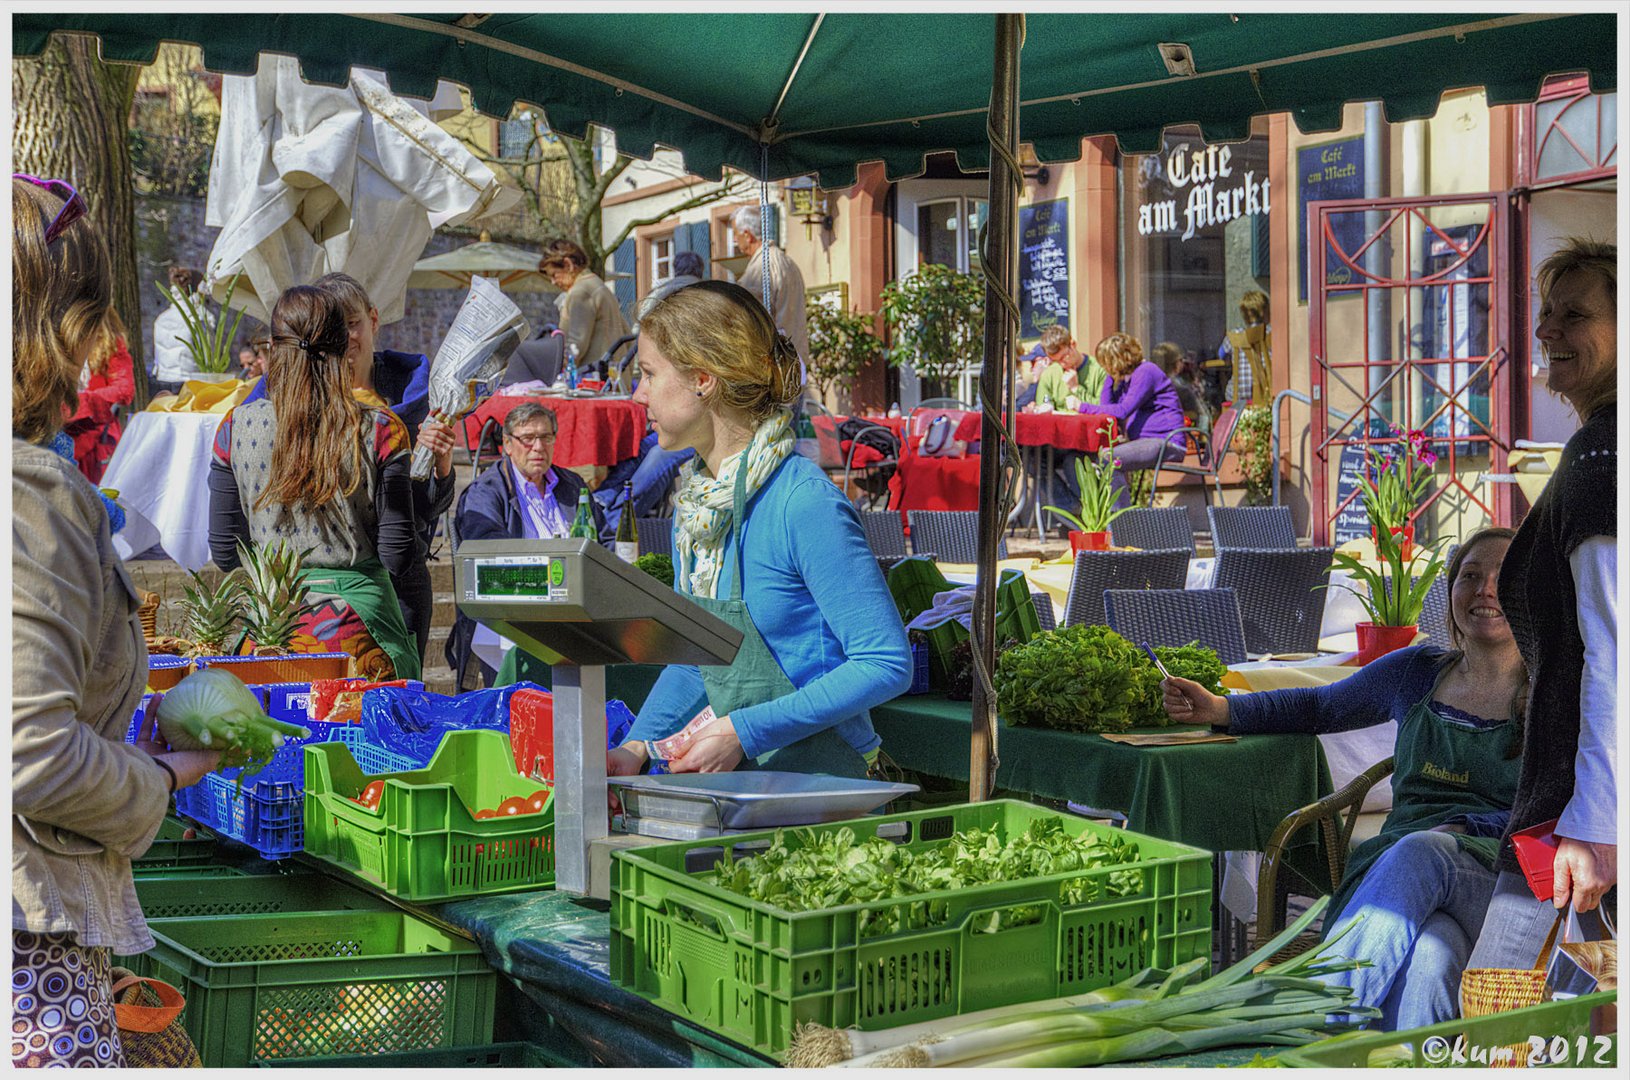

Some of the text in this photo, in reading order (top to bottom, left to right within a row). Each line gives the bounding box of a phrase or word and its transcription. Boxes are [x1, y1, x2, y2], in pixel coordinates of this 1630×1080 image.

[1321, 146, 1343, 163] Café
[1308, 163, 1356, 184] am Markt
[1138, 170, 1271, 242] am Markt
[1422, 761, 1469, 784] Bioland
